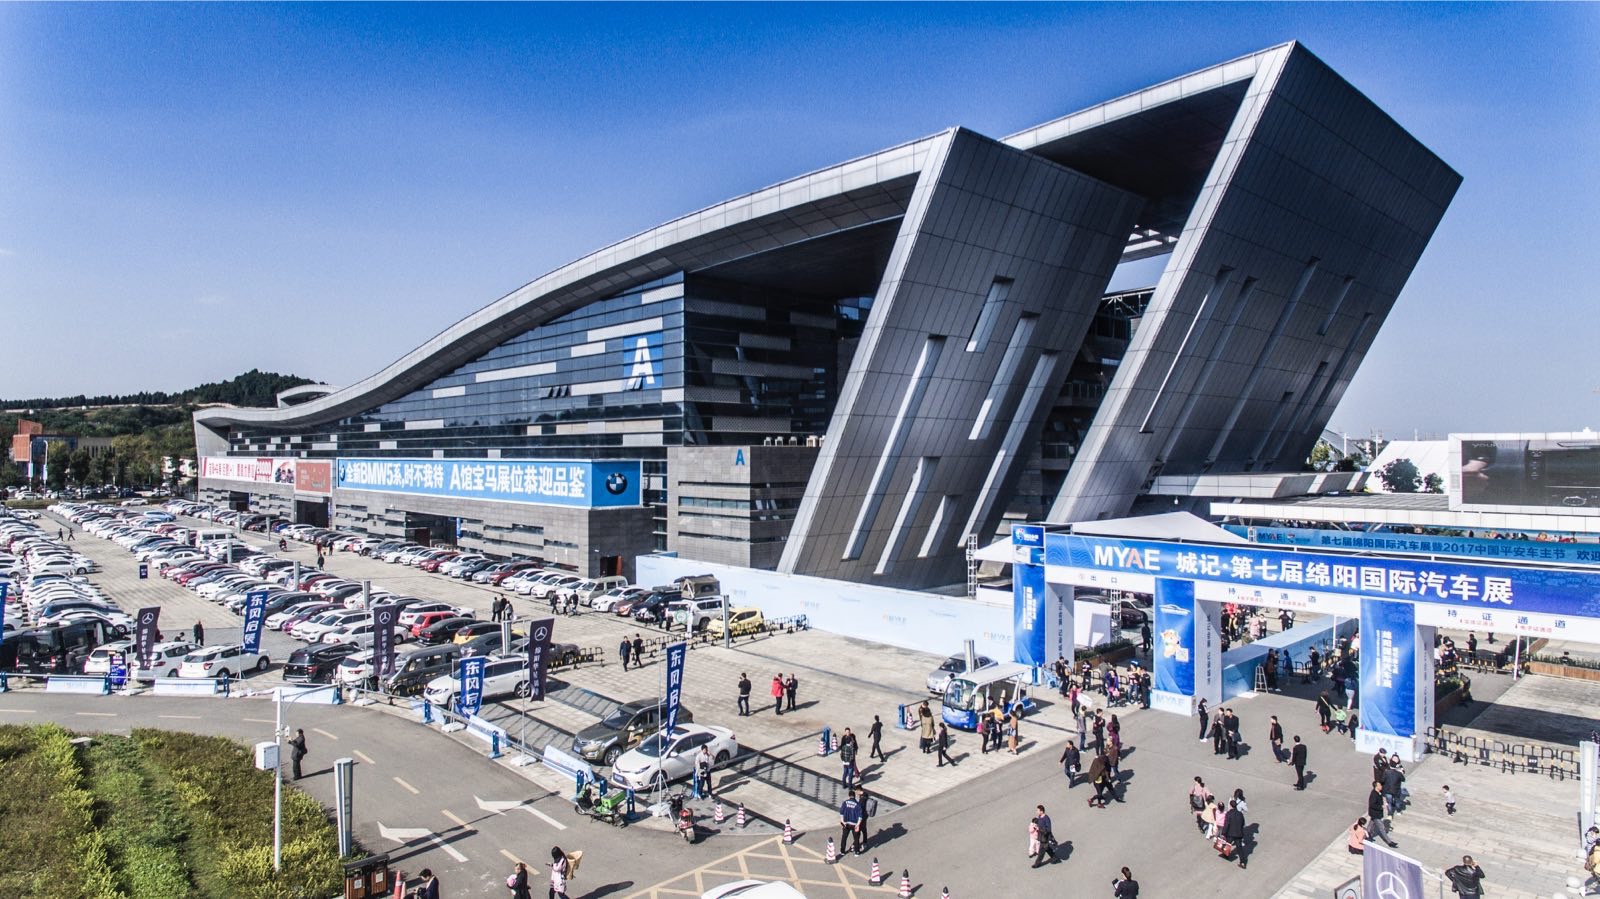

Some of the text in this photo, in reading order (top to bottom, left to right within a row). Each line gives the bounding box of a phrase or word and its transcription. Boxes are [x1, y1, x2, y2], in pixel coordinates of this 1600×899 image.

[627, 337, 655, 386] A
[735, 449, 745, 465] A
[450, 463, 585, 498] A馆宝马展位恭迎品鉴
[1257, 532, 1283, 541] MYAE
[1094, 545, 1161, 571] MYAE
